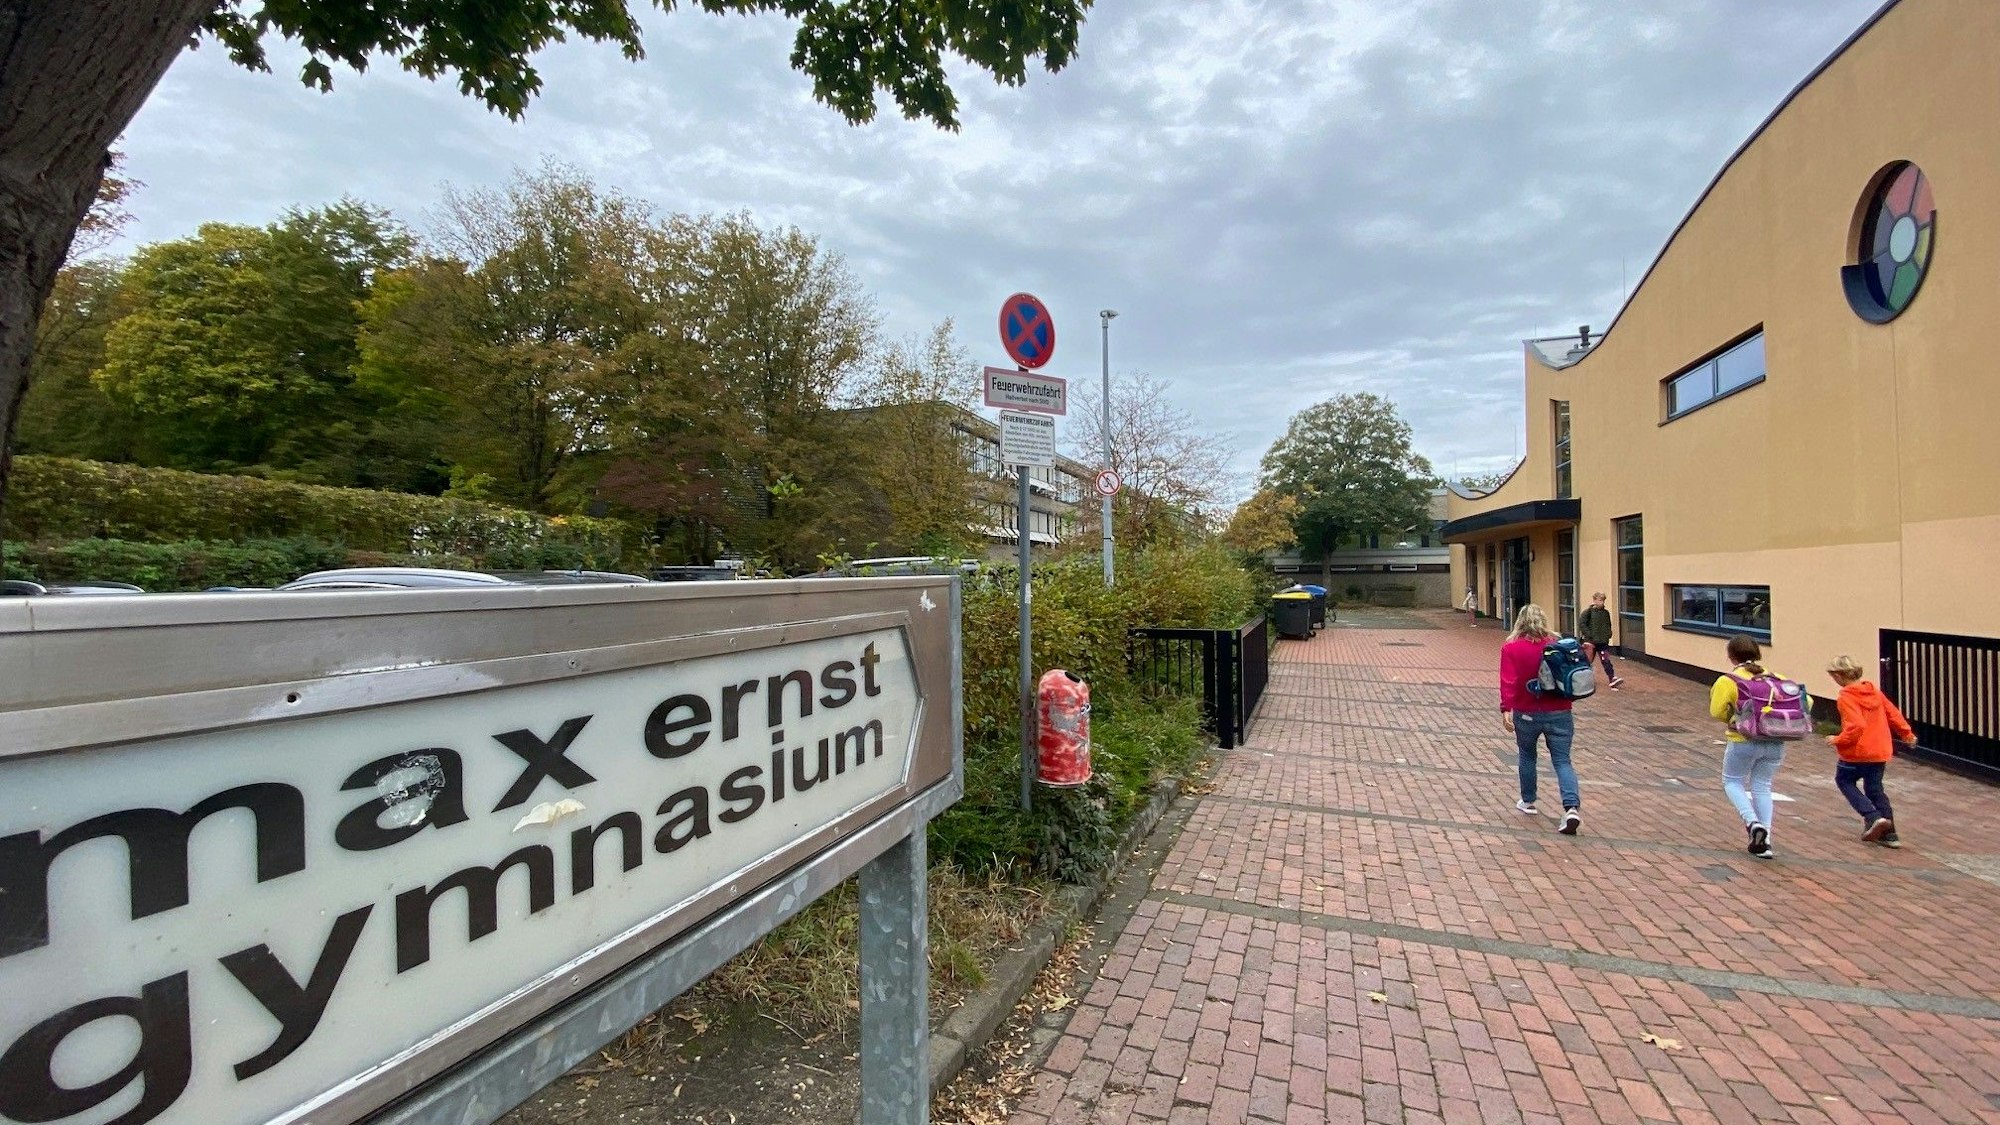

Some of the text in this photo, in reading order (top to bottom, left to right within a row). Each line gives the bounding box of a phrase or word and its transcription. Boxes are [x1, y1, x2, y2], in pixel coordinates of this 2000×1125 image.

[992, 377, 1061, 399] Feuerwehrzufahrt
[0, 641, 882, 958] max ernst
[0, 718, 884, 1125] gymnasium
